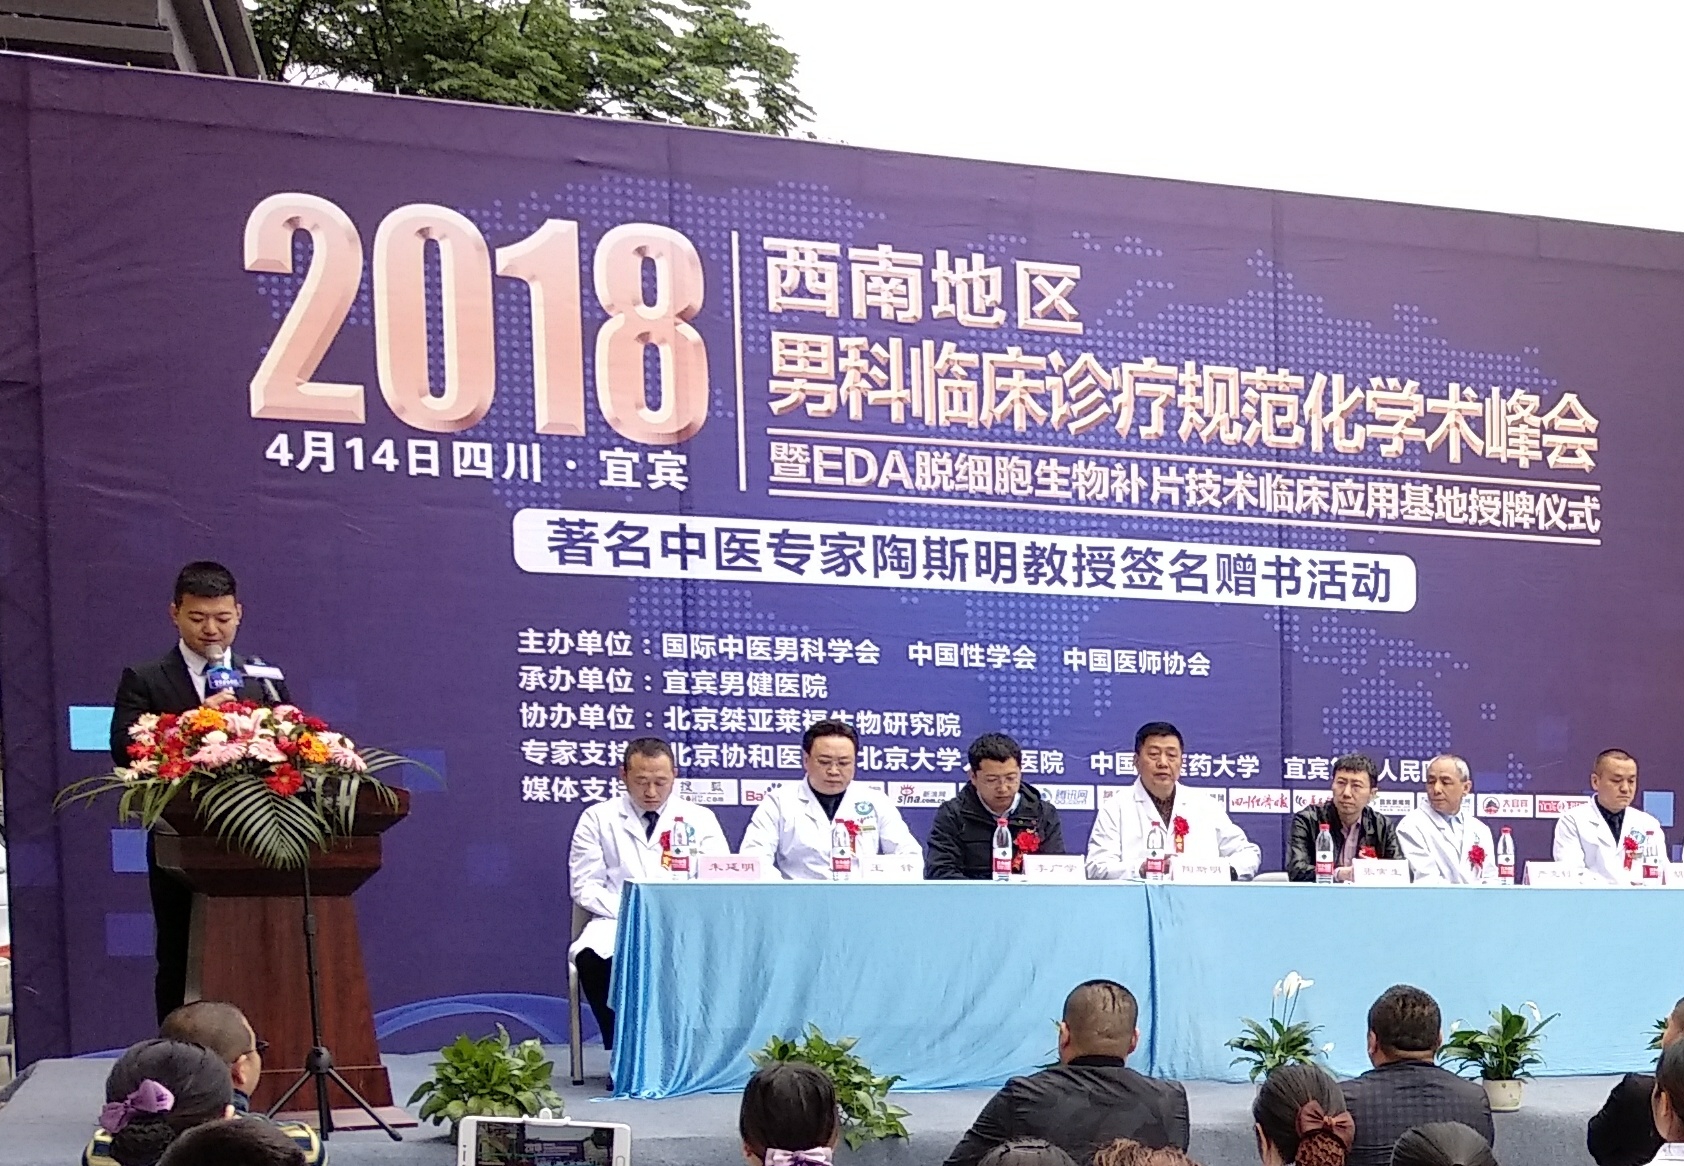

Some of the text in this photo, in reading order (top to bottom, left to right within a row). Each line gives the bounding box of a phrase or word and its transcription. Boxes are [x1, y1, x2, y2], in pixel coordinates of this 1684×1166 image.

[244, 191, 710, 445] 2018
[762, 233, 1084, 335] 西南地区
[767, 330, 1600, 473] 男科临床诊疗规范化学术峰会
[768, 441, 1600, 534] 暨EDA脱细胞生物补片技术临床应用基地授牌仪式
[547, 518, 1391, 603] 著名中医专家陶斯明教授签名赠书活动
[907, 640, 1037, 671] 中国性学会
[1062, 648, 1211, 678] 中国医师协会
[857, 745, 1065, 775] 北京大学医院
